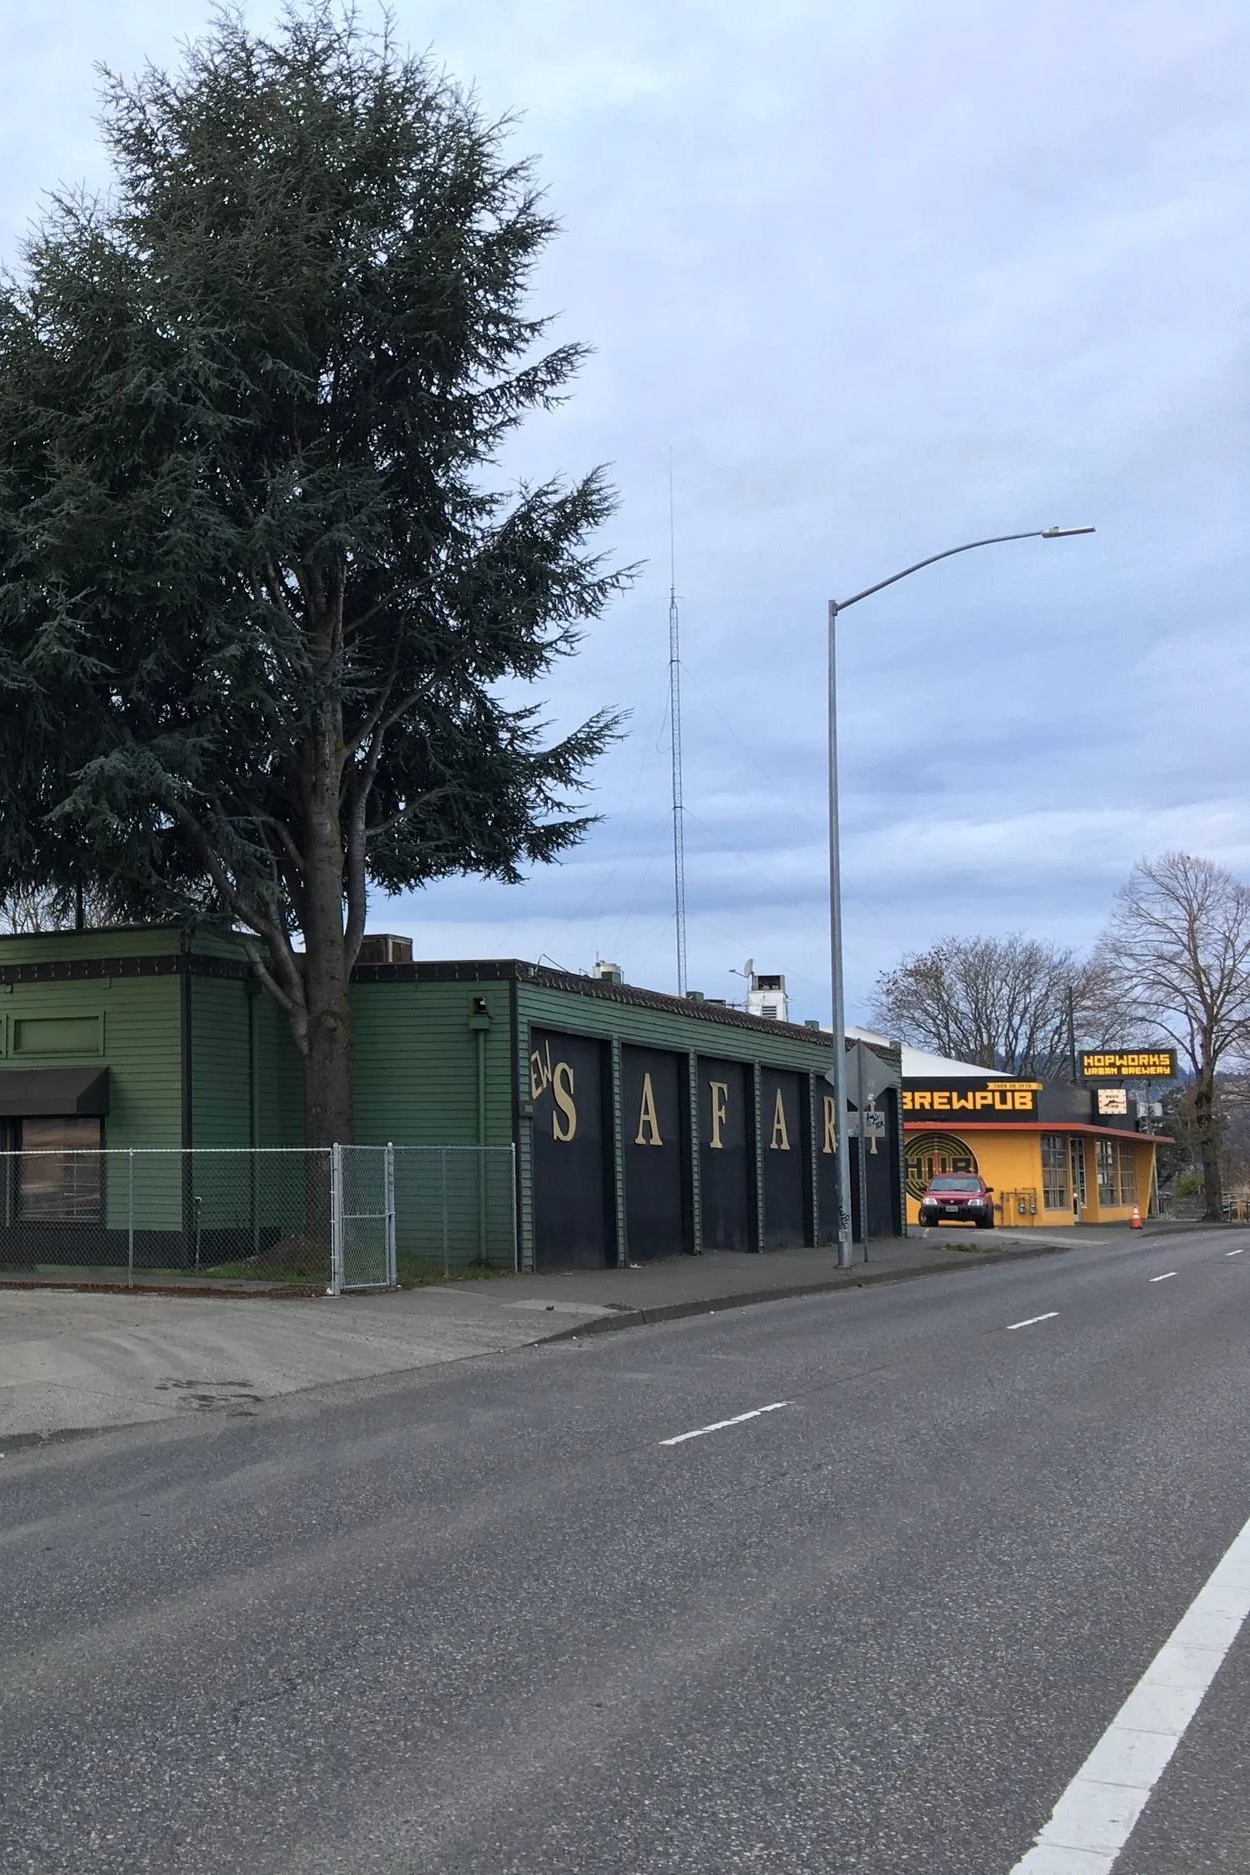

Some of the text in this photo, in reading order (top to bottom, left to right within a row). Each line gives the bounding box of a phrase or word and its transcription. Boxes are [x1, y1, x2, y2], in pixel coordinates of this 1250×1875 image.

[1083, 1054, 1170, 1066] HOPWORKS
[1084, 1066, 1171, 1076] URBAN BREWERY
[902, 1091, 1033, 1110] BREWPUB
